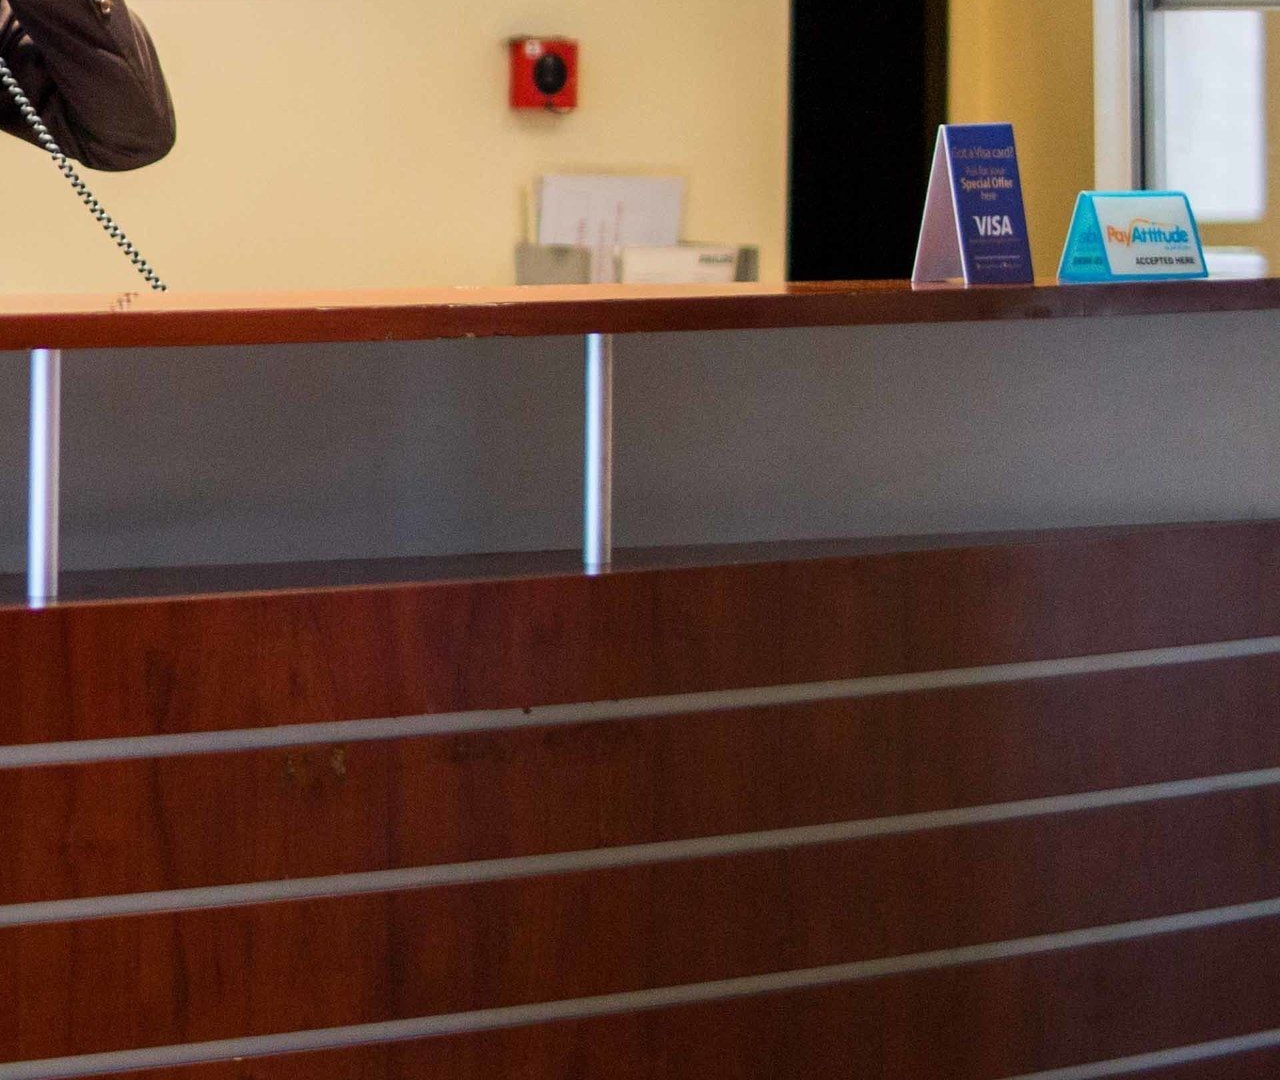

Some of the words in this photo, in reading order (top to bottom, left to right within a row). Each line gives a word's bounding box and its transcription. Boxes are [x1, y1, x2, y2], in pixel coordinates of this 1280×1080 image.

[961, 178, 990, 192] Special
[991, 177, 1013, 189] Offer
[973, 215, 1013, 236] VISA
[1106, 223, 1189, 247] PayAttitude
[1136, 256, 1174, 266] ACCEPTED
[1176, 256, 1195, 265] HERE
